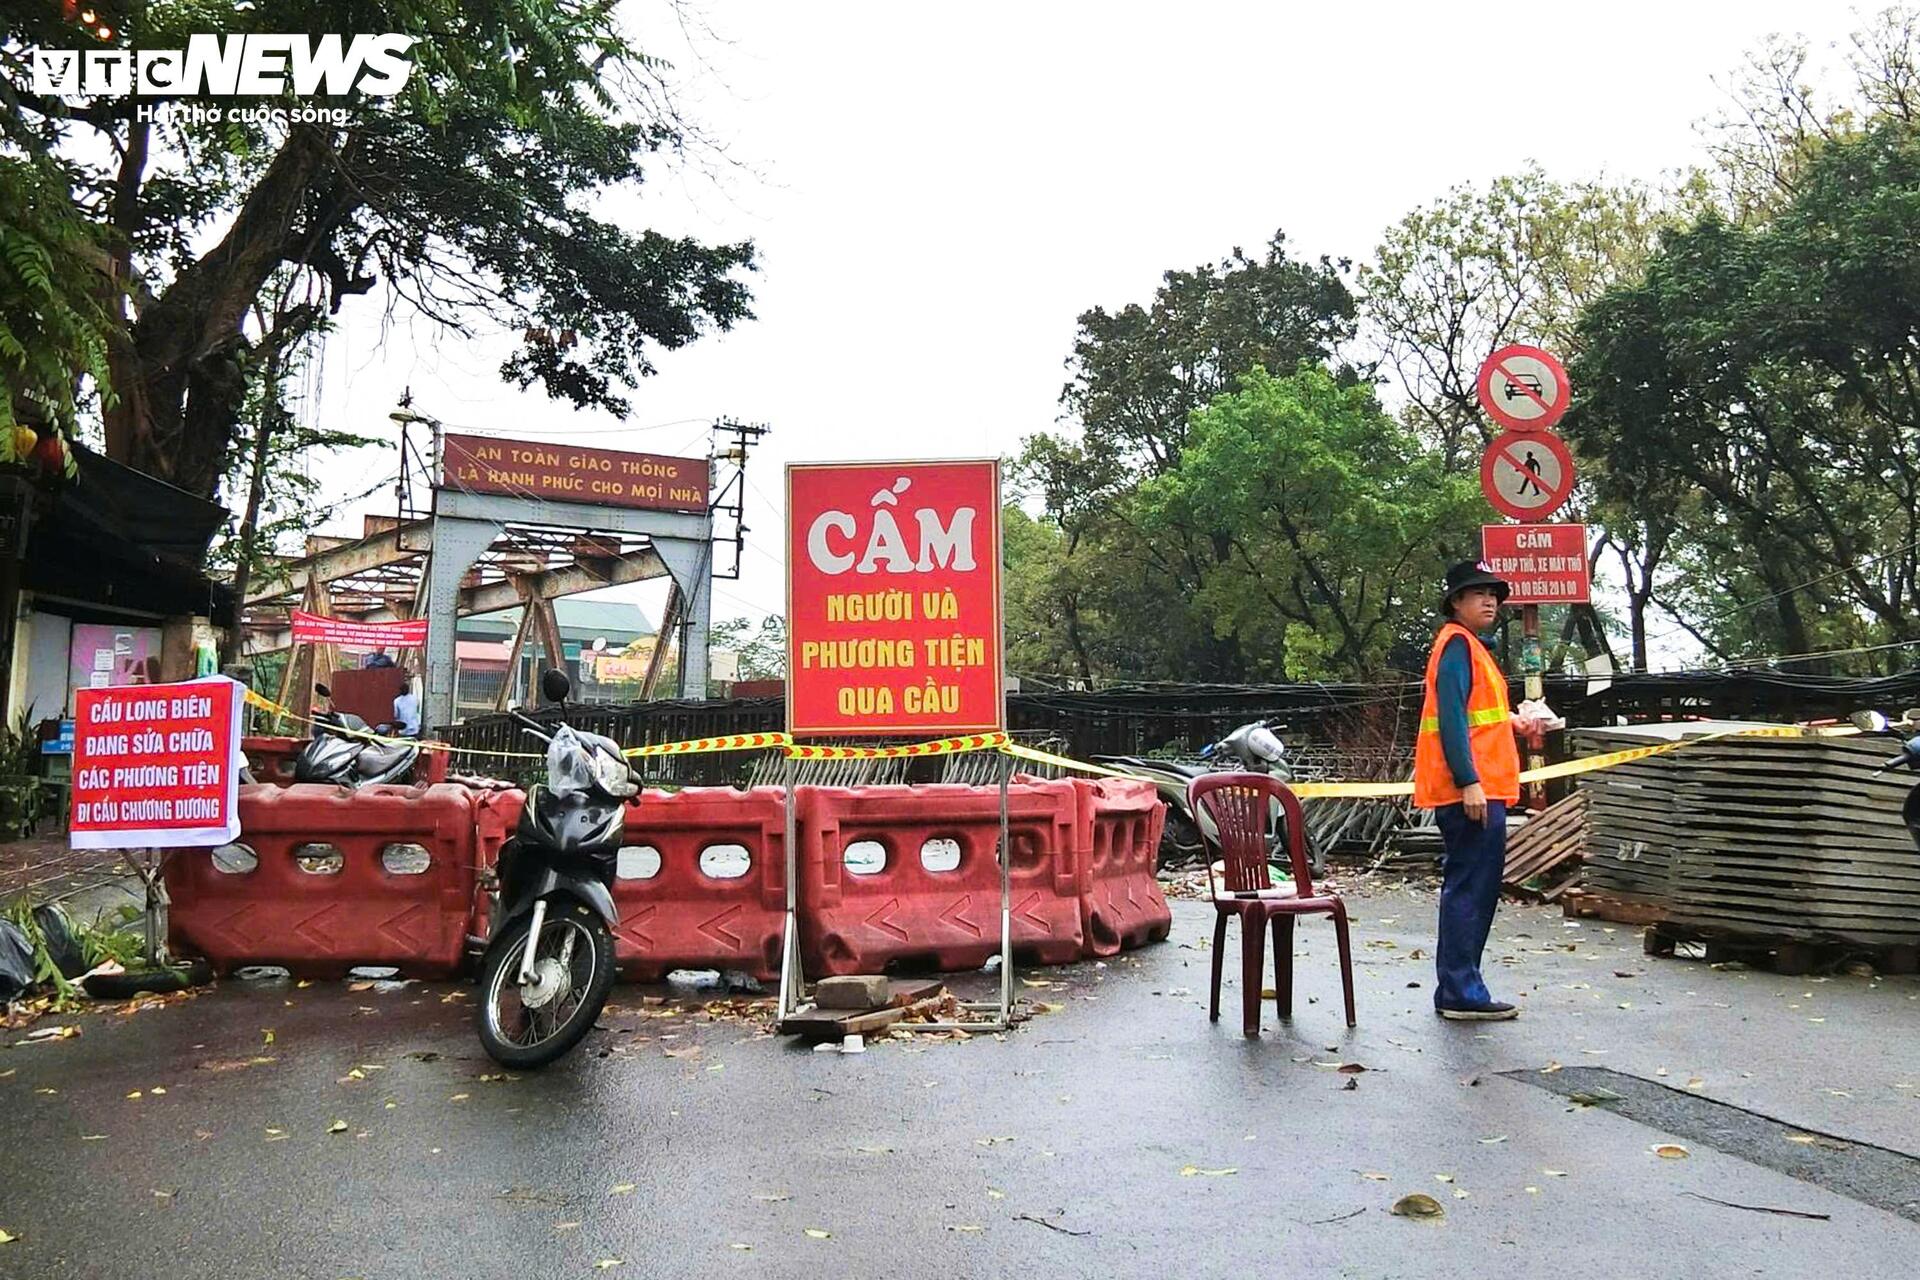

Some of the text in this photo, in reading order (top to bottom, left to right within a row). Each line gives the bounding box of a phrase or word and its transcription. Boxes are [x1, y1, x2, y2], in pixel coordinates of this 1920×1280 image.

[476, 446, 502, 460] AN
[511, 445, 560, 466] TOÀN
[621, 458, 679, 478] THÔNG
[457, 462, 479, 481] LÀ
[542, 472, 584, 491] PHÚC
[592, 480, 623, 495] CHO
[631, 482, 663, 502] MỌI
[669, 486, 702, 503] NHÀ
[807, 476, 977, 575] CẤM
[1516, 528, 1553, 549] CẤM
[1491, 557, 1502, 573] XE
[1537, 557, 1548, 572] XE
[827, 586, 959, 622] NGƯỜI VÀ
[802, 633, 985, 672] PHƯƠNG TIỆN
[126, 700, 167, 721] LONG
[171, 694, 211, 719] BIÊN
[838, 675, 960, 716] QUA CẦU
[86, 735, 128, 756] ĐANG
[133, 728, 164, 755] SỬA
[169, 728, 213, 752] CHỮA
[79, 761, 219, 789] CÁC PHƯƠNG TIỆN
[77, 802, 90, 822] ĐI
[121, 798, 172, 821] CHƯƠNG
[175, 797, 219, 820] DƯƠNG
